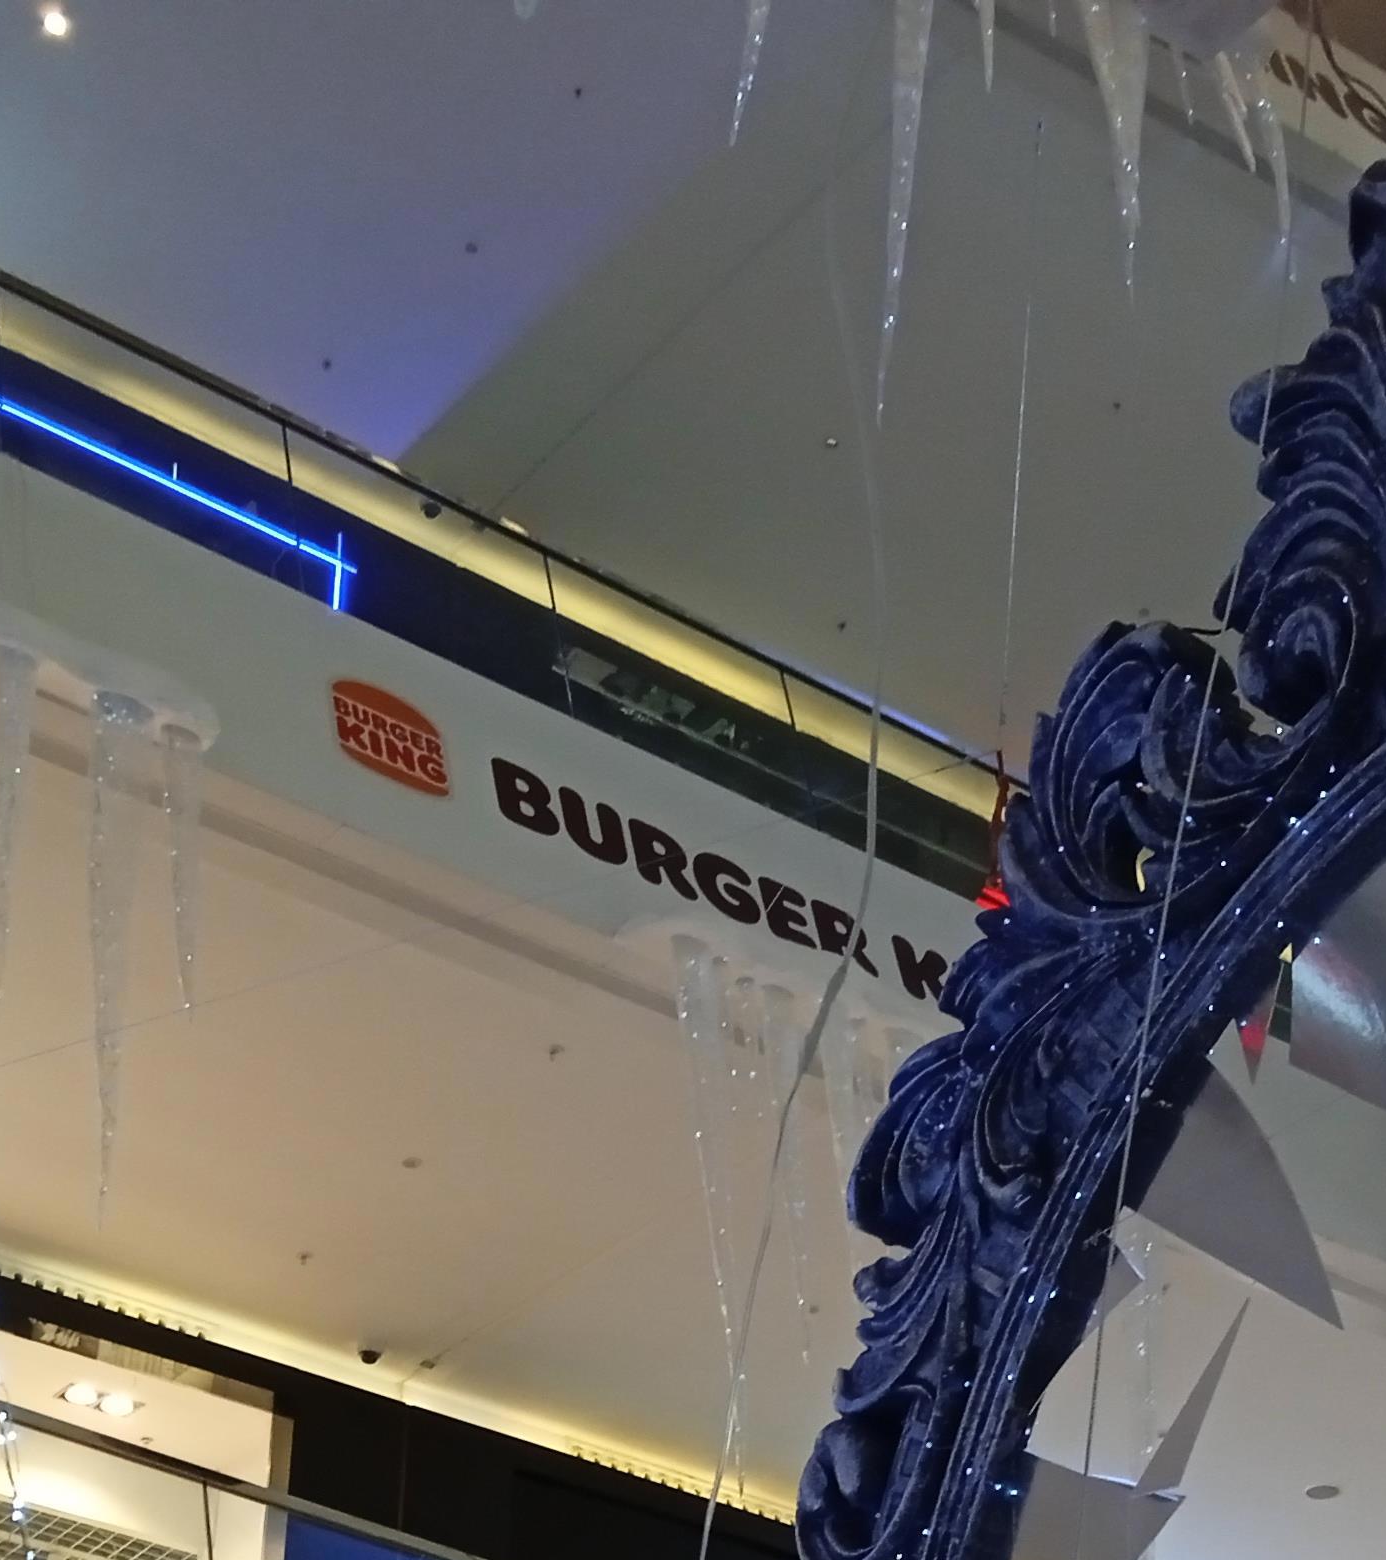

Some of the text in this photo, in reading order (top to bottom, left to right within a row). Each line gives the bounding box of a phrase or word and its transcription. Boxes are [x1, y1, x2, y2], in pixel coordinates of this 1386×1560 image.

[333, 695, 444, 760] BURGER
[336, 715, 448, 785] KING
[491, 757, 880, 978] BURGER
